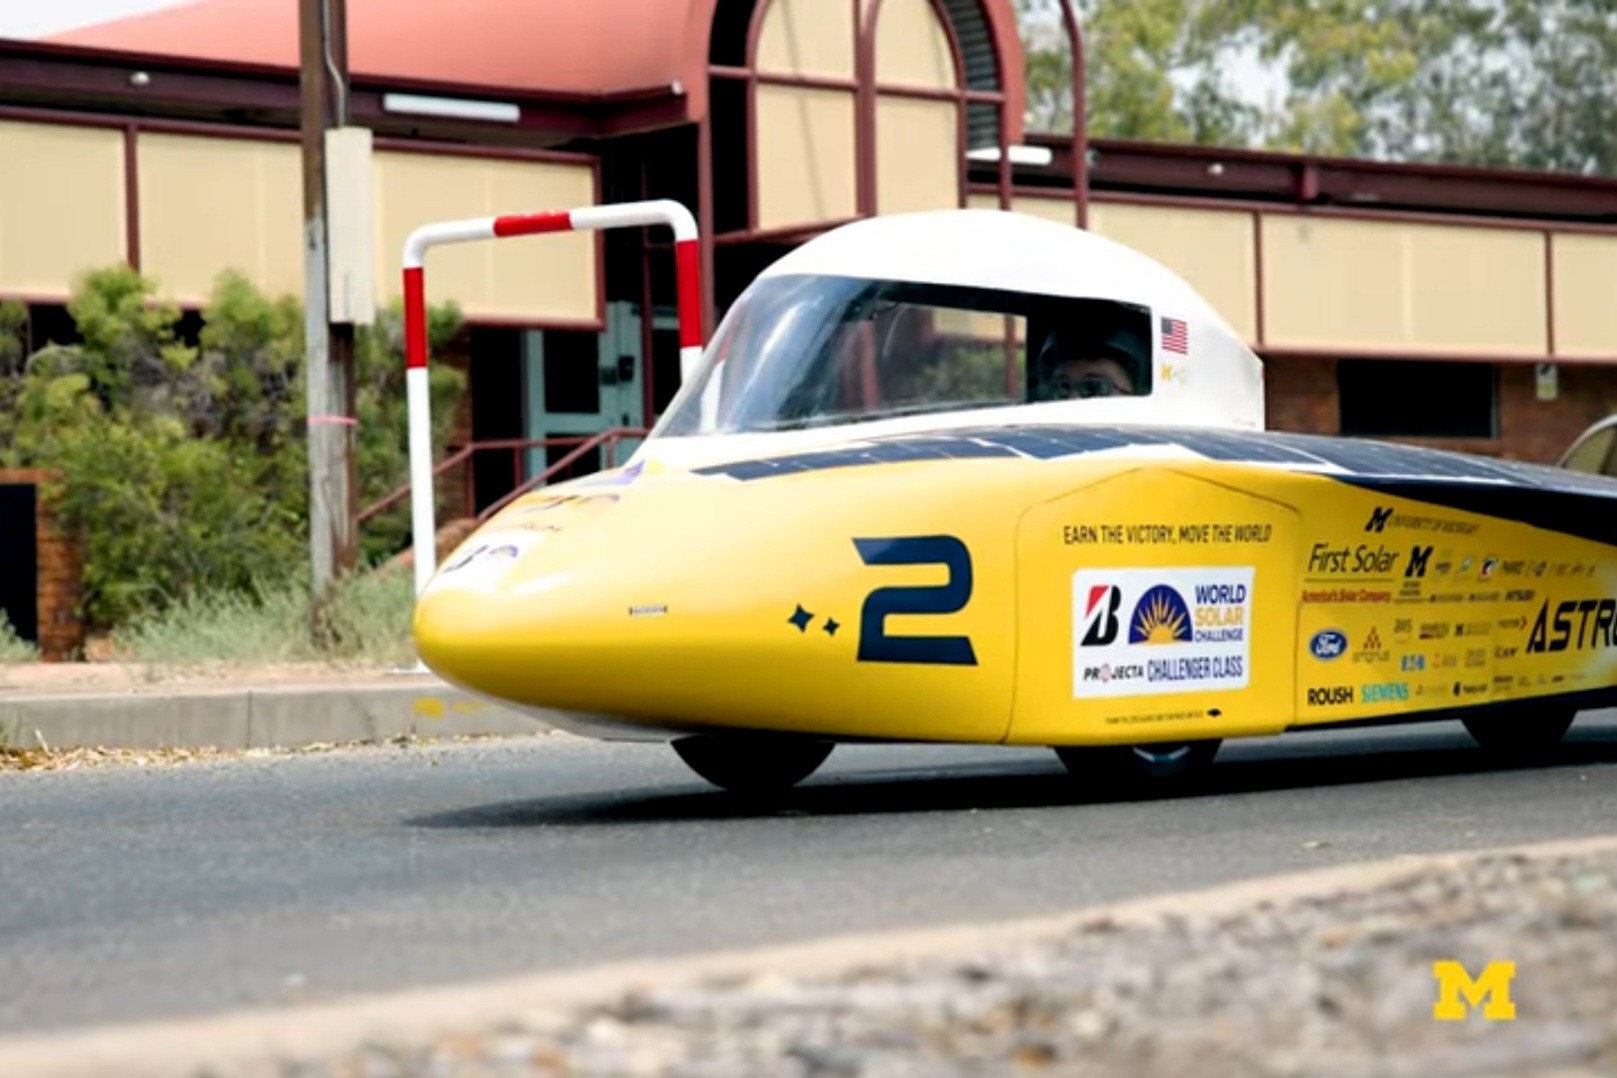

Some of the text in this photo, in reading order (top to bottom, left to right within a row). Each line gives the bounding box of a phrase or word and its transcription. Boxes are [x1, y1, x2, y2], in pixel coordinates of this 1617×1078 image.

[1064, 524, 1272, 545] EARN THE VICTORY, MOVE THE WORLD
[1308, 542, 1400, 572] First Solar
[1404, 545, 1434, 577] M
[851, 534, 978, 666] 2
[1195, 584, 1247, 604] WORLD
[1194, 607, 1243, 626] SOLAR
[1525, 597, 1617, 653] ASTR
[1194, 628, 1243, 642] CHALLENGE
[1315, 633, 1342, 654] Ford
[1083, 665, 1144, 683] PROJECTA
[1147, 656, 1243, 683] CHALLENGER CLASS
[1307, 686, 1353, 706] ROUSH
